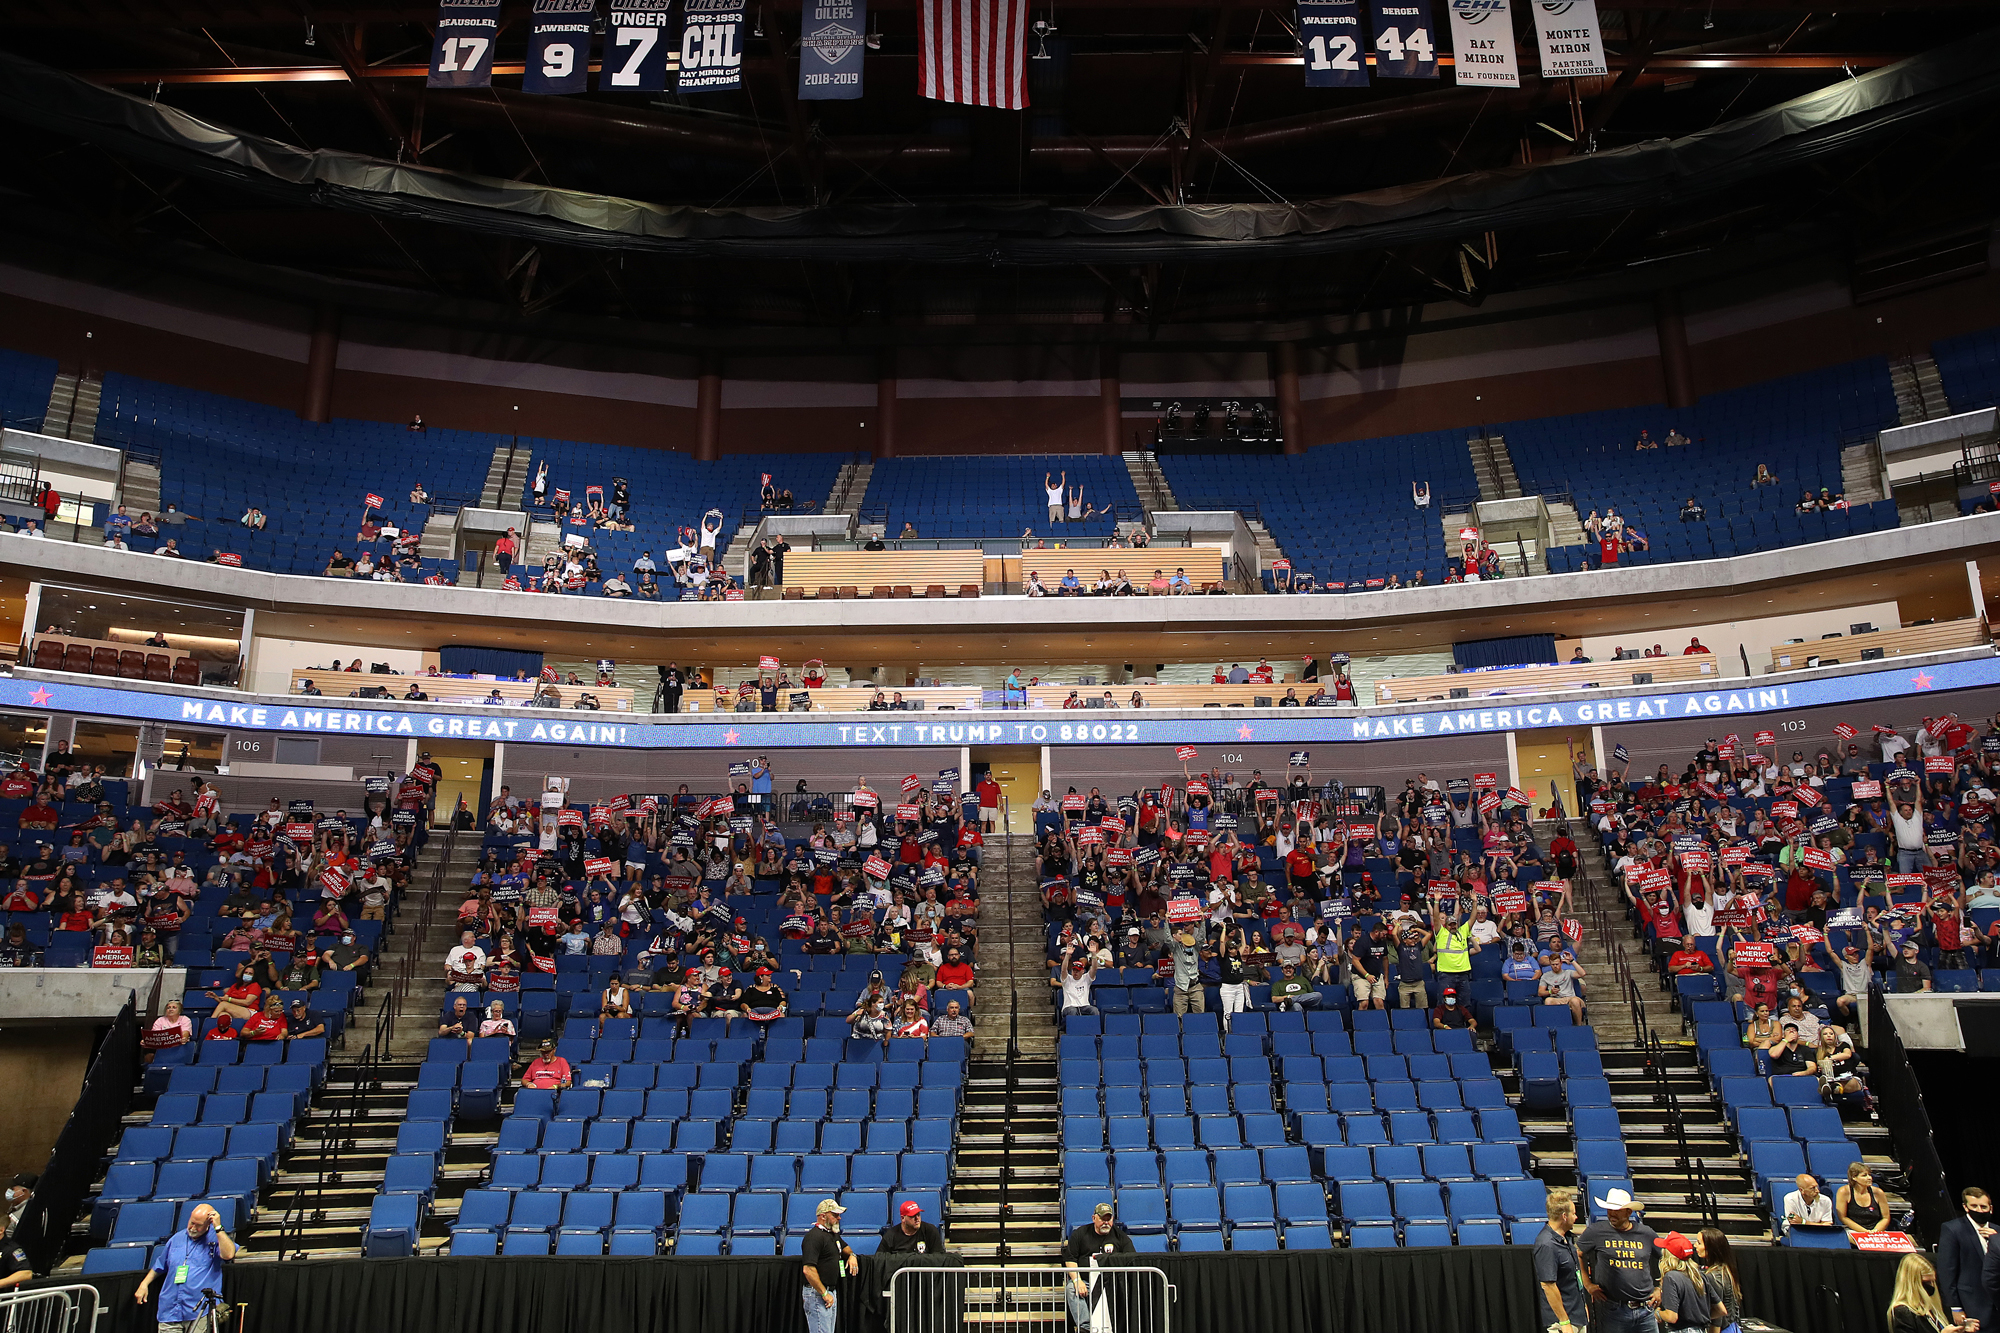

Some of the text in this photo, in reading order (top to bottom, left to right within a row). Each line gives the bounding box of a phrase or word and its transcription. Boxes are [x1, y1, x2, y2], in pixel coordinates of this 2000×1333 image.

[611, 12, 666, 26] UNGER
[686, 14, 743, 24] 1992-1993
[815, 7, 853, 20] OILERS
[439, 19, 497, 28] BEAUSOLEIL
[1302, 16, 1356, 25] WAKEFORD
[534, 25, 589, 33] LAWRENCE
[1546, 29, 1590, 40] MONTE
[681, 24, 741, 69] CHL
[802, 39, 864, 47] CHAMPIONS
[1376, 27, 1433, 61] 44
[1470, 40, 1495, 49] RAY
[1549, 43, 1591, 54] MIRON
[438, 37, 489, 72] 17
[611, 27, 659, 86] 7
[1309, 36, 1359, 70] 12
[1465, 54, 1504, 64] MIRON
[543, 44, 574, 77] 9
[1543, 67, 1606, 76] COMMISSIONER
[679, 75, 740, 87] CHAMPIONS
[805, 73, 858, 85] 2018-2019
[1353, 688, 1789, 737] MAKE AMERICA GREAT AGAIN!
[182, 702, 626, 742] MAKE AMERICA GREAT AGAIN!
[1781, 720, 1806, 732] 103
[838, 724, 1138, 742] TEXT TRUMP TO 88022
[235, 741, 260, 752] 106
[1221, 754, 1242, 762] 104
[324, 872, 344, 891] AMERICA
[1641, 876, 1668, 885] AMERICA
[713, 905, 731, 919] AMERICA
[1605, 1240, 1643, 1250] DEFEND
[1616, 1250, 1635, 1258] THE
[1609, 1258, 1644, 1270] POLICE
